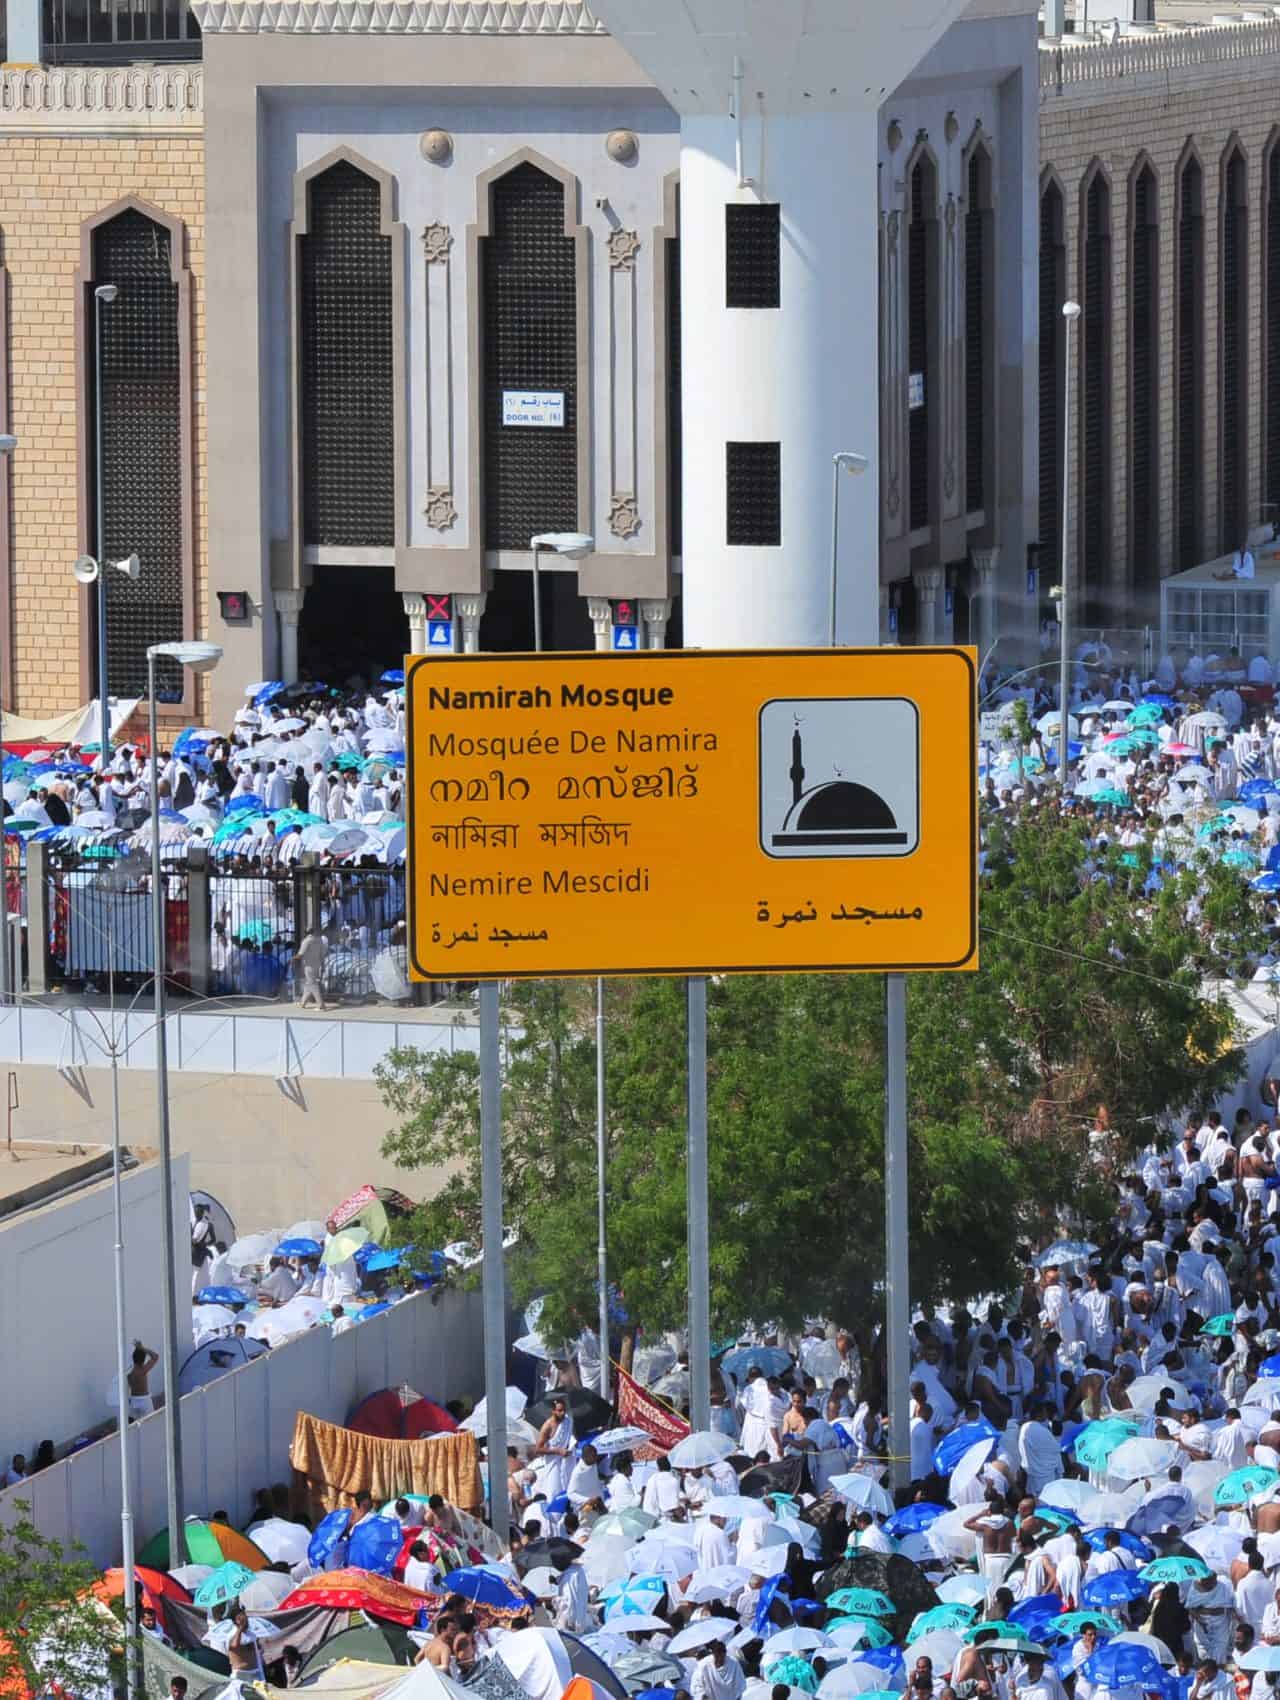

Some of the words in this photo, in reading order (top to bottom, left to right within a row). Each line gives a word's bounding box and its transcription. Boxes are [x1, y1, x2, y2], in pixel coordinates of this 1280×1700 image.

[506, 413, 529, 422] DOOR
[428, 685, 552, 710] Namirah
[560, 684, 674, 712] Mosque
[428, 729, 560, 761] Mosquée
[570, 730, 606, 754] De
[617, 727, 718, 753] Namira
[430, 769, 531, 802] നമീറ
[557, 763, 699, 800] മസ്ജിദ്
[430, 816, 520, 850] নামিরা
[537, 815, 633, 848] মসজিদ
[429, 871, 533, 897] Nemire
[543, 867, 649, 894] Mescidi
[756, 900, 818, 929] نمرة
[830, 904, 923, 926] مسجد
[431, 922, 479, 949] نمرة
[488, 925, 549, 948] مسجد
